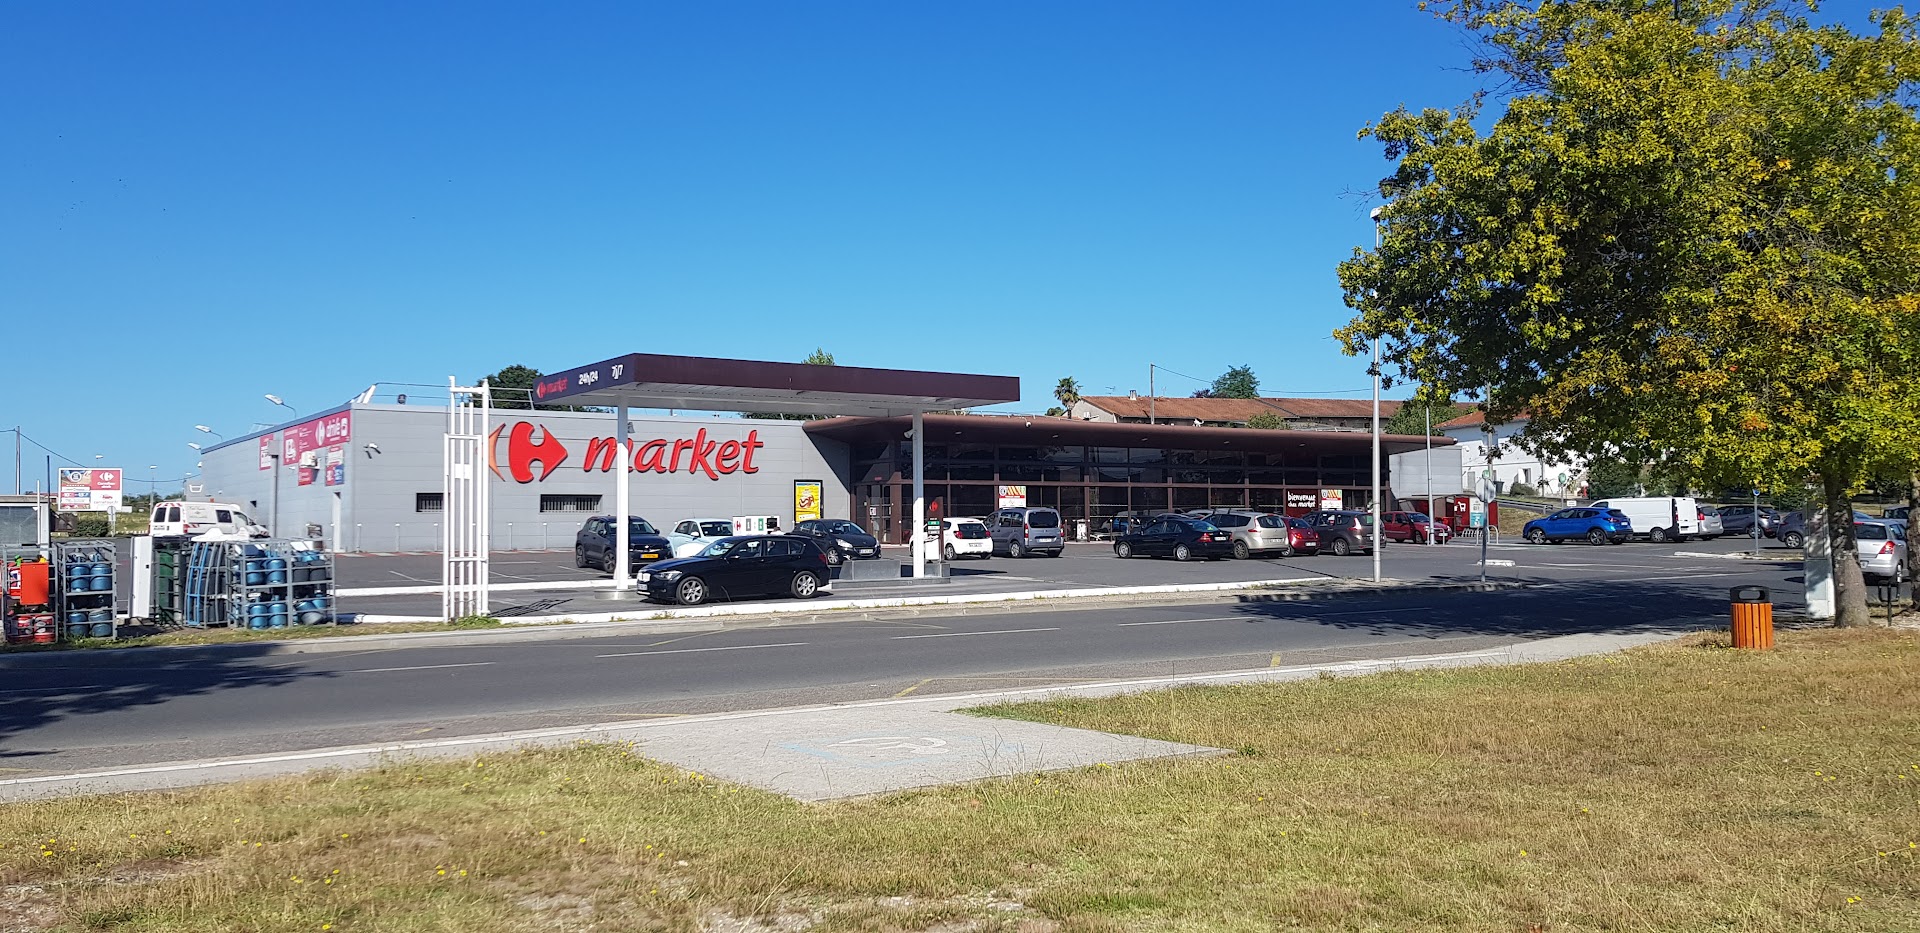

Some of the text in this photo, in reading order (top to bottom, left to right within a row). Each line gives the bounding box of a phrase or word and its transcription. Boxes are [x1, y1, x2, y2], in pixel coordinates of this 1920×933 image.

[547, 377, 568, 393] market
[578, 370, 599, 386] 24h/24
[583, 427, 764, 481] market
[1287, 491, 1316, 501] bienvenue
